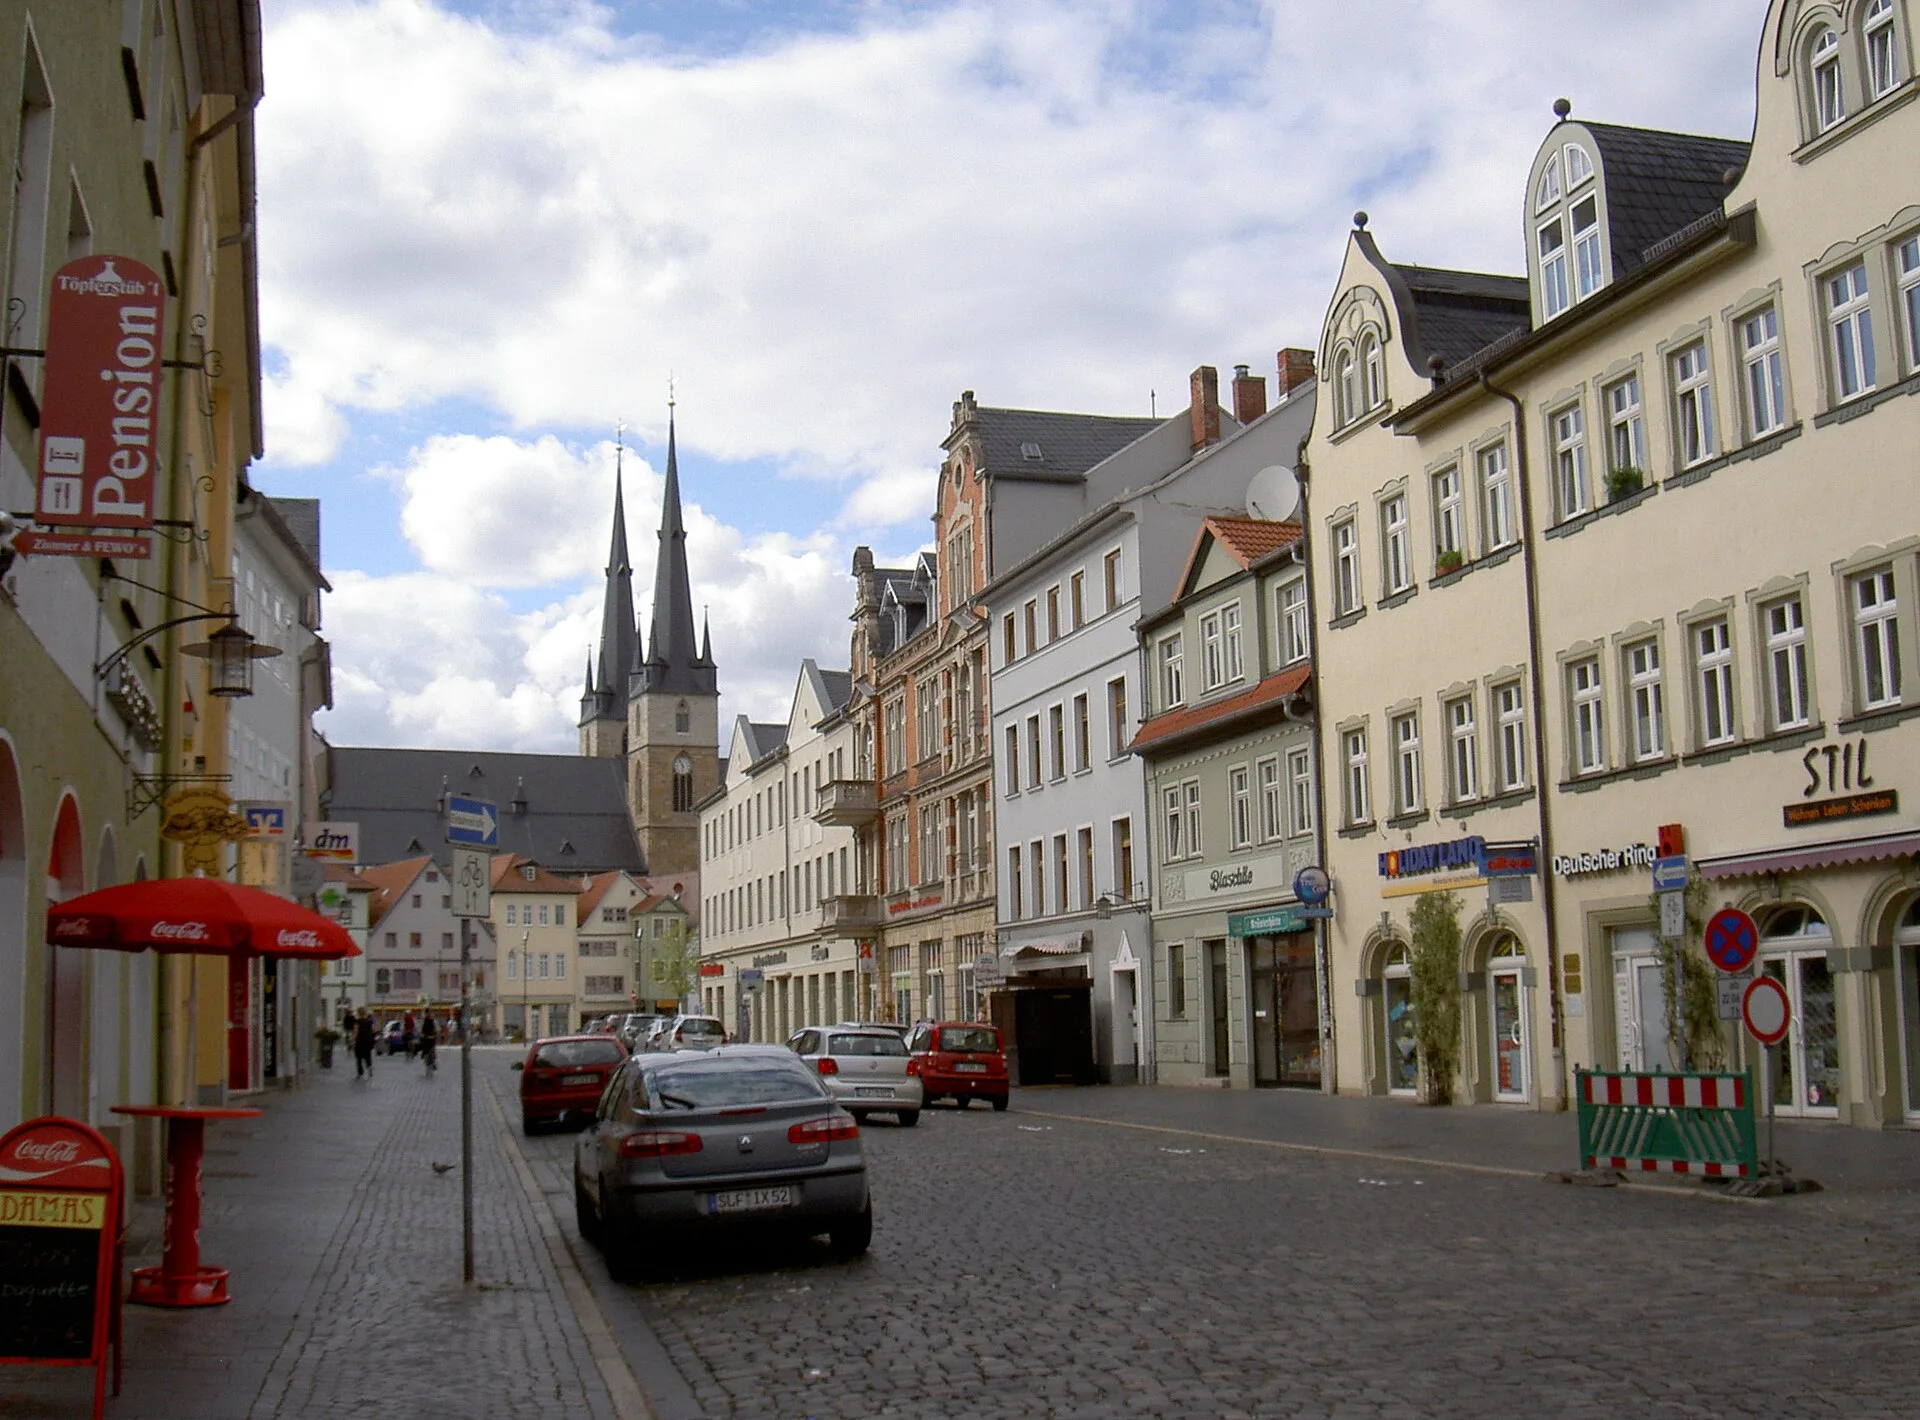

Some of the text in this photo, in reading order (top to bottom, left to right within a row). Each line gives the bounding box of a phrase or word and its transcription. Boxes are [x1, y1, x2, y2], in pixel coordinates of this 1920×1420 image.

[93, 305, 157, 518] Pension
[32, 538, 81, 552] Zimmer
[1803, 738, 1874, 797] STIL
[315, 828, 349, 849] dm
[1378, 835, 1485, 876] HOLIDAY LAND
[1552, 843, 1657, 876] Deutscher Ring
[151, 920, 206, 940] Coca-Cola
[14, 1139, 81, 1162] Coca-Cola
